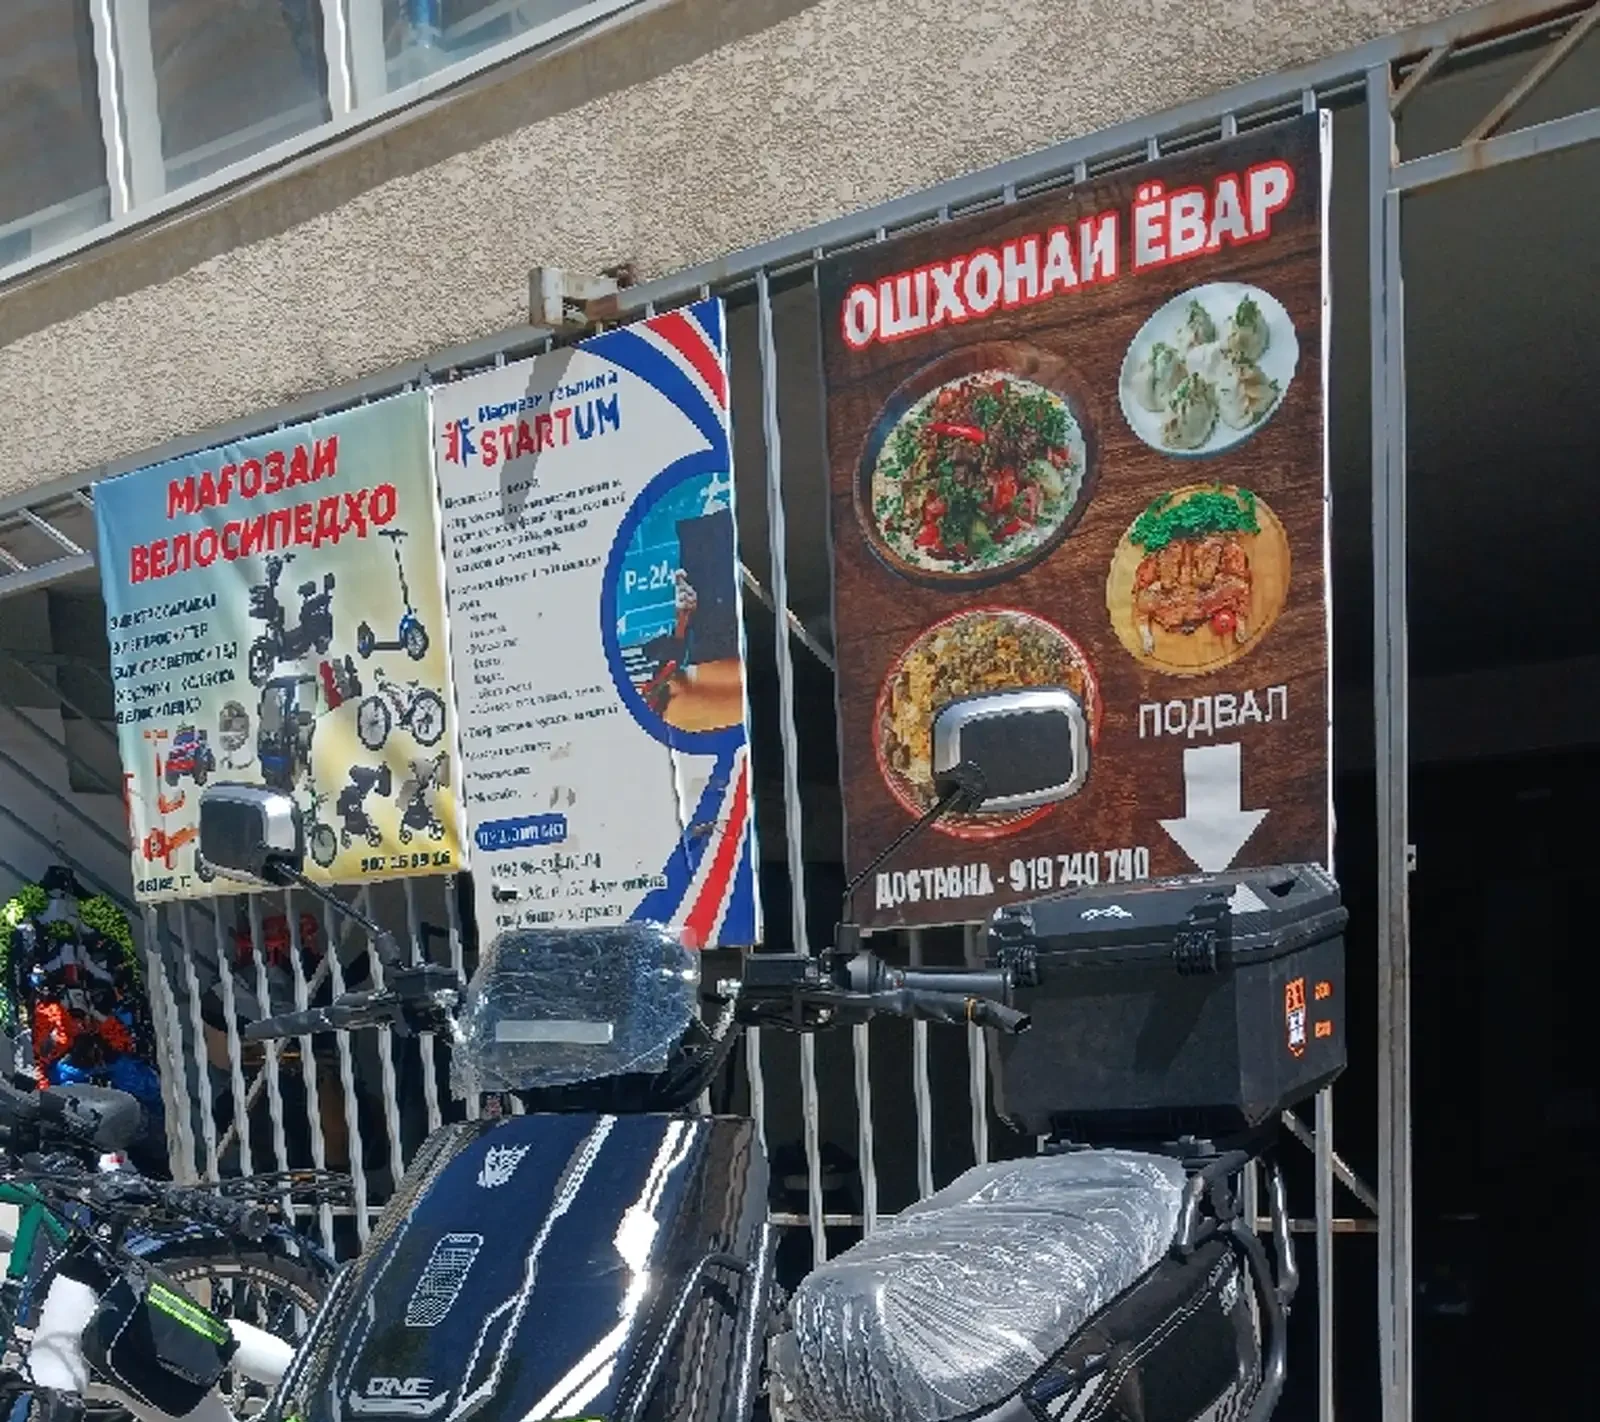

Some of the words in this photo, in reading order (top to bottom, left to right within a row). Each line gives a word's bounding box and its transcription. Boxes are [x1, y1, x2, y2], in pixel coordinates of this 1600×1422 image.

[843, 213, 1118, 348] ОШХОНАИ
[1132, 163, 1292, 270] ЁВАР
[480, 393, 620, 467] STARTUM
[1139, 685, 1288, 739] ПОДВАЛ
[875, 863, 994, 910] ДОСТАВКА
[1009, 856, 1053, 892] 919
[1056, 850, 1099, 888] 740
[1103, 846, 1149, 884] 740
